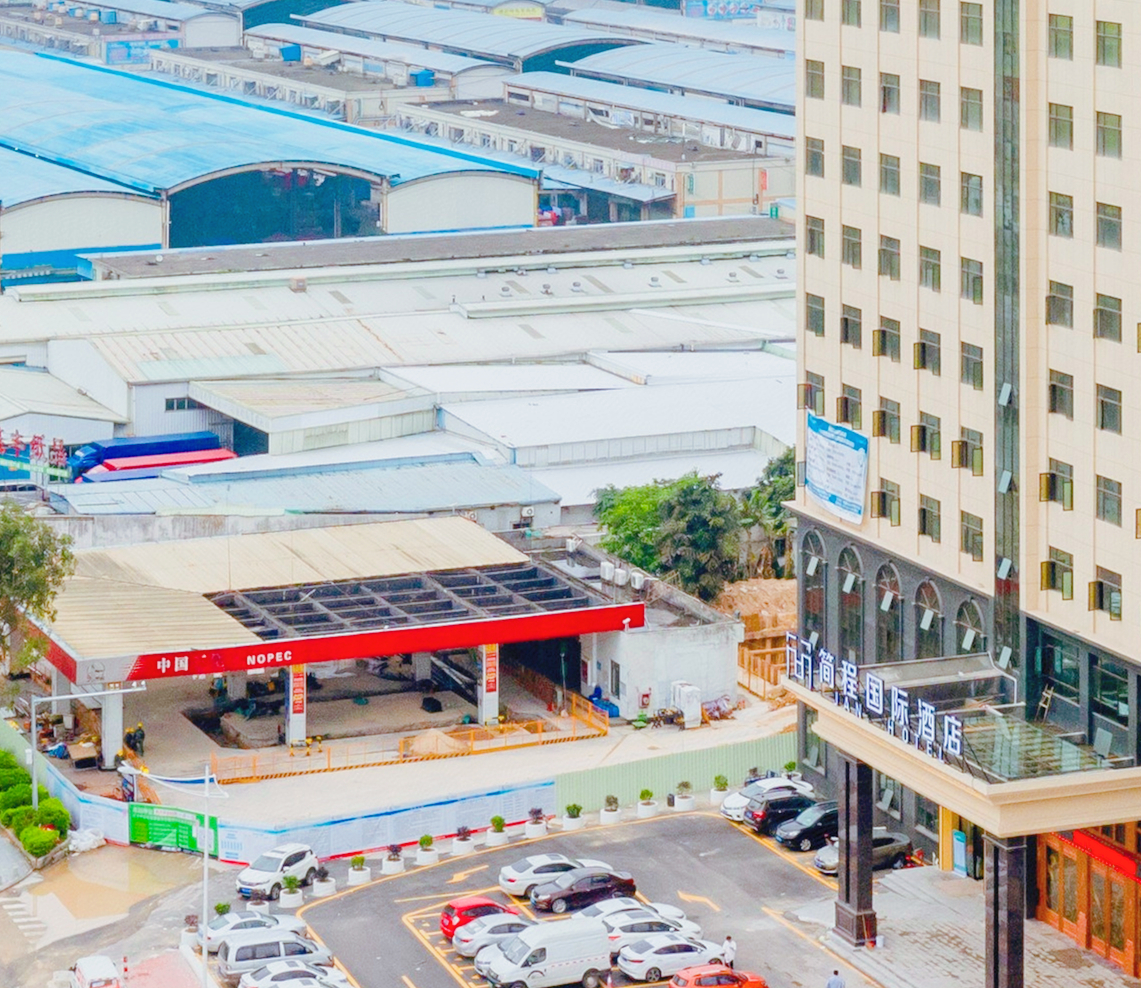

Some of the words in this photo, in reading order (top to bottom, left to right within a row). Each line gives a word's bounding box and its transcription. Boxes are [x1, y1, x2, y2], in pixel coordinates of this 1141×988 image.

[156, 656, 189, 673] 中国
[246, 650, 292, 665] NOPEC
[819, 648, 964, 756] 简程国际酒店
[886, 719, 945, 764] HOTEL
